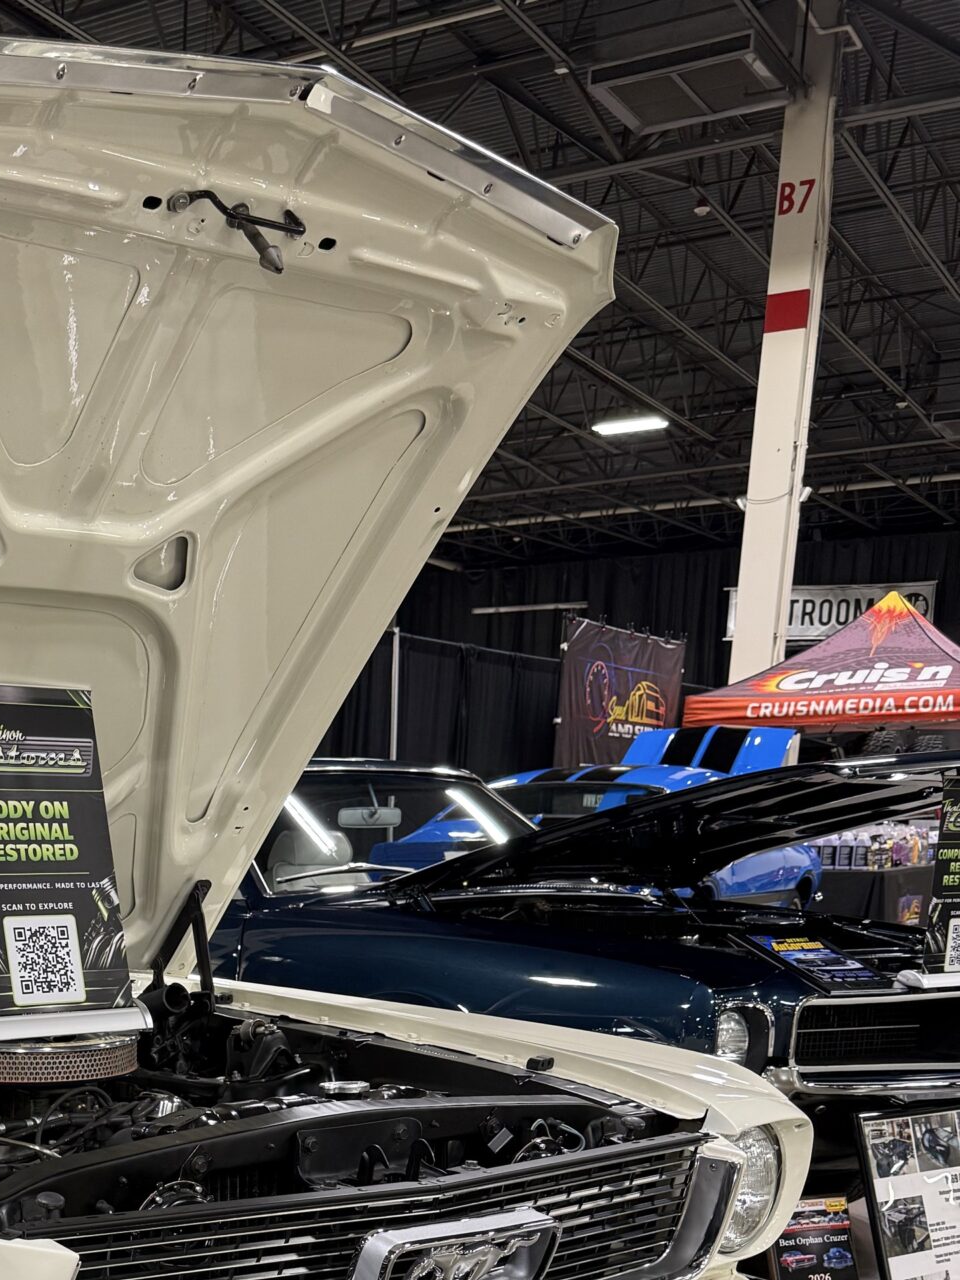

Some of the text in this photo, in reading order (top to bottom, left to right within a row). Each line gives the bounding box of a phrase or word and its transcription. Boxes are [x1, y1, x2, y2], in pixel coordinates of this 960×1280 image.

[778, 179, 816, 216] B7
[746, 695, 955, 718] CRUISNMEDIA.COM
[39, 801, 70, 819] ON
[38, 902, 74, 910] EXPLORE
[771, 942, 824, 951] Autorama
[797, 1236, 823, 1246] Orphan
